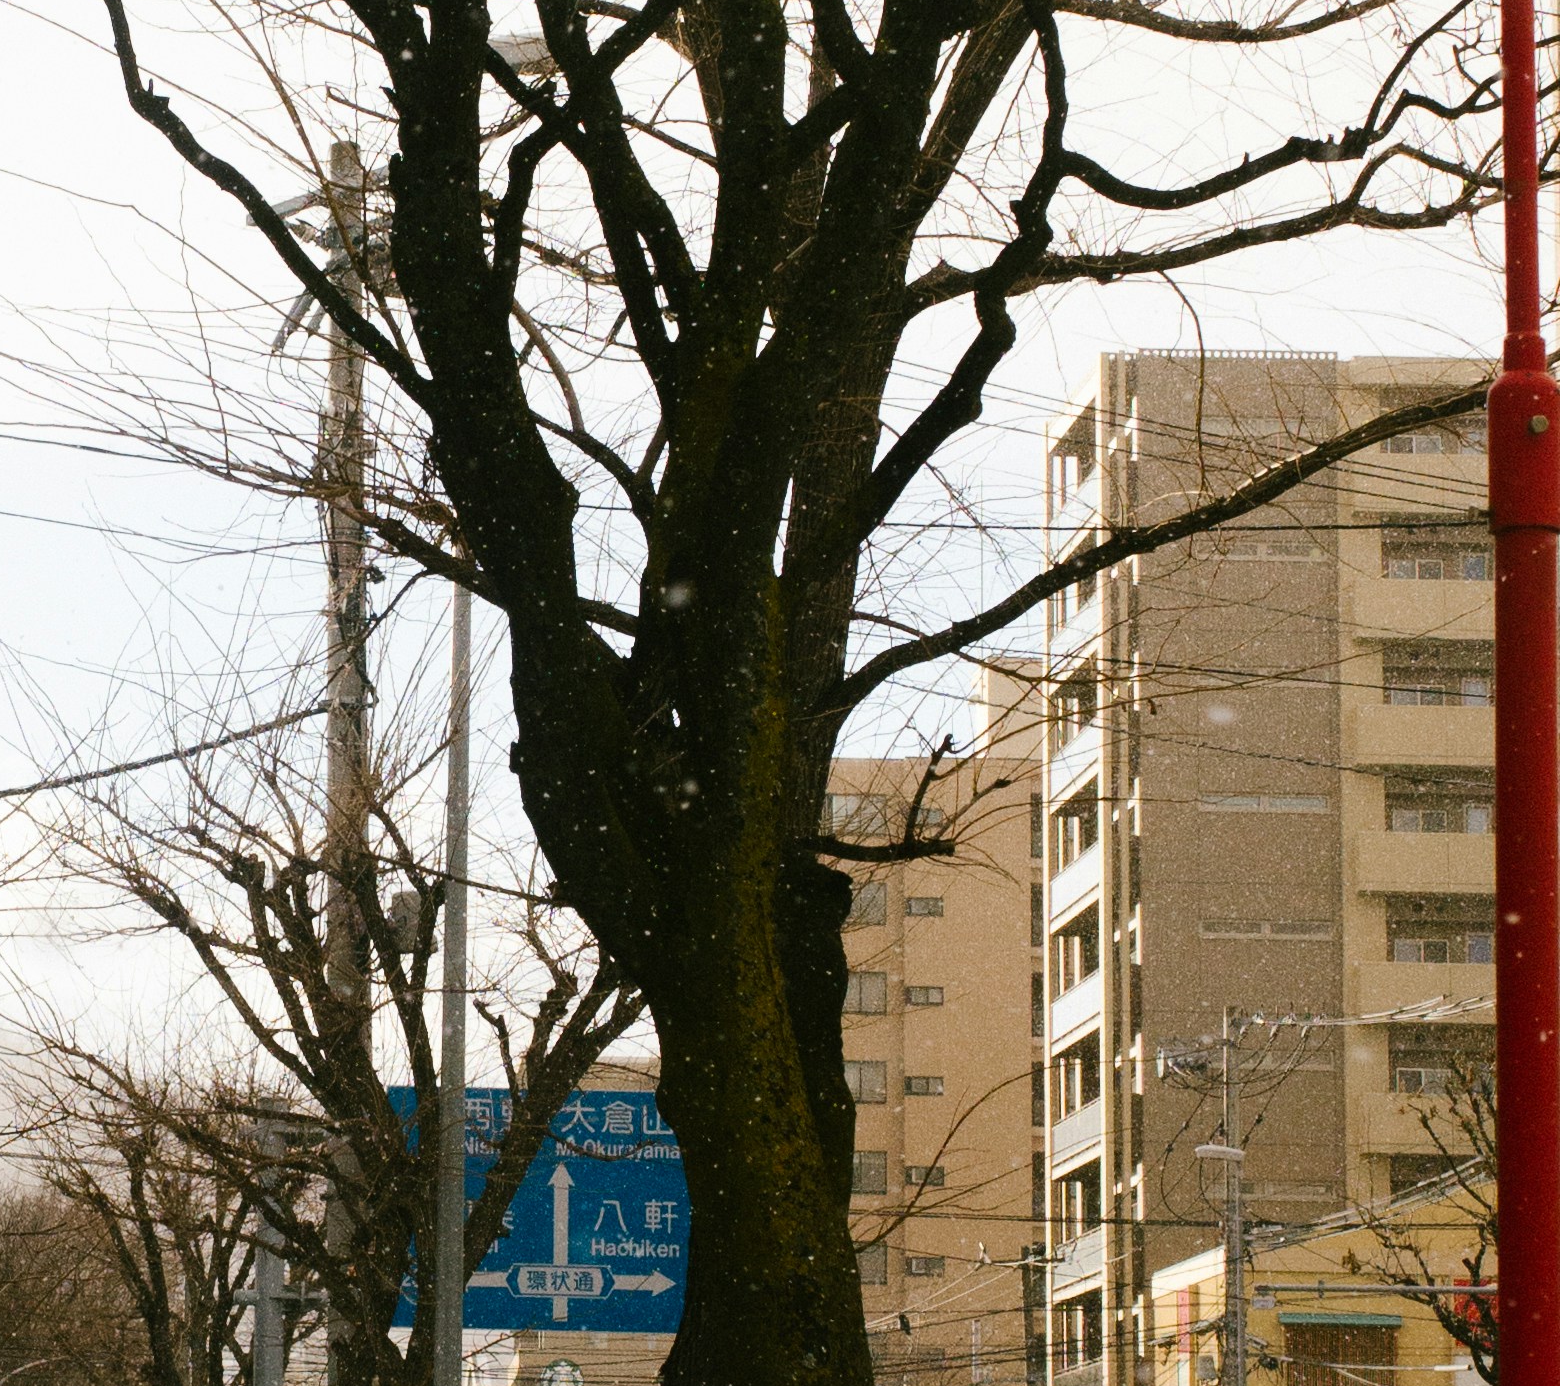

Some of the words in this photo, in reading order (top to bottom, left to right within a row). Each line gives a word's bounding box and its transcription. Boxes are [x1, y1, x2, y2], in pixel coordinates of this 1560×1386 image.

[560, 1099, 674, 1135] 大倉山
[594, 1198, 679, 1235] 八軒
[590, 1237, 681, 1258] Hachiken
[526, 1270, 594, 1293] 環状通
